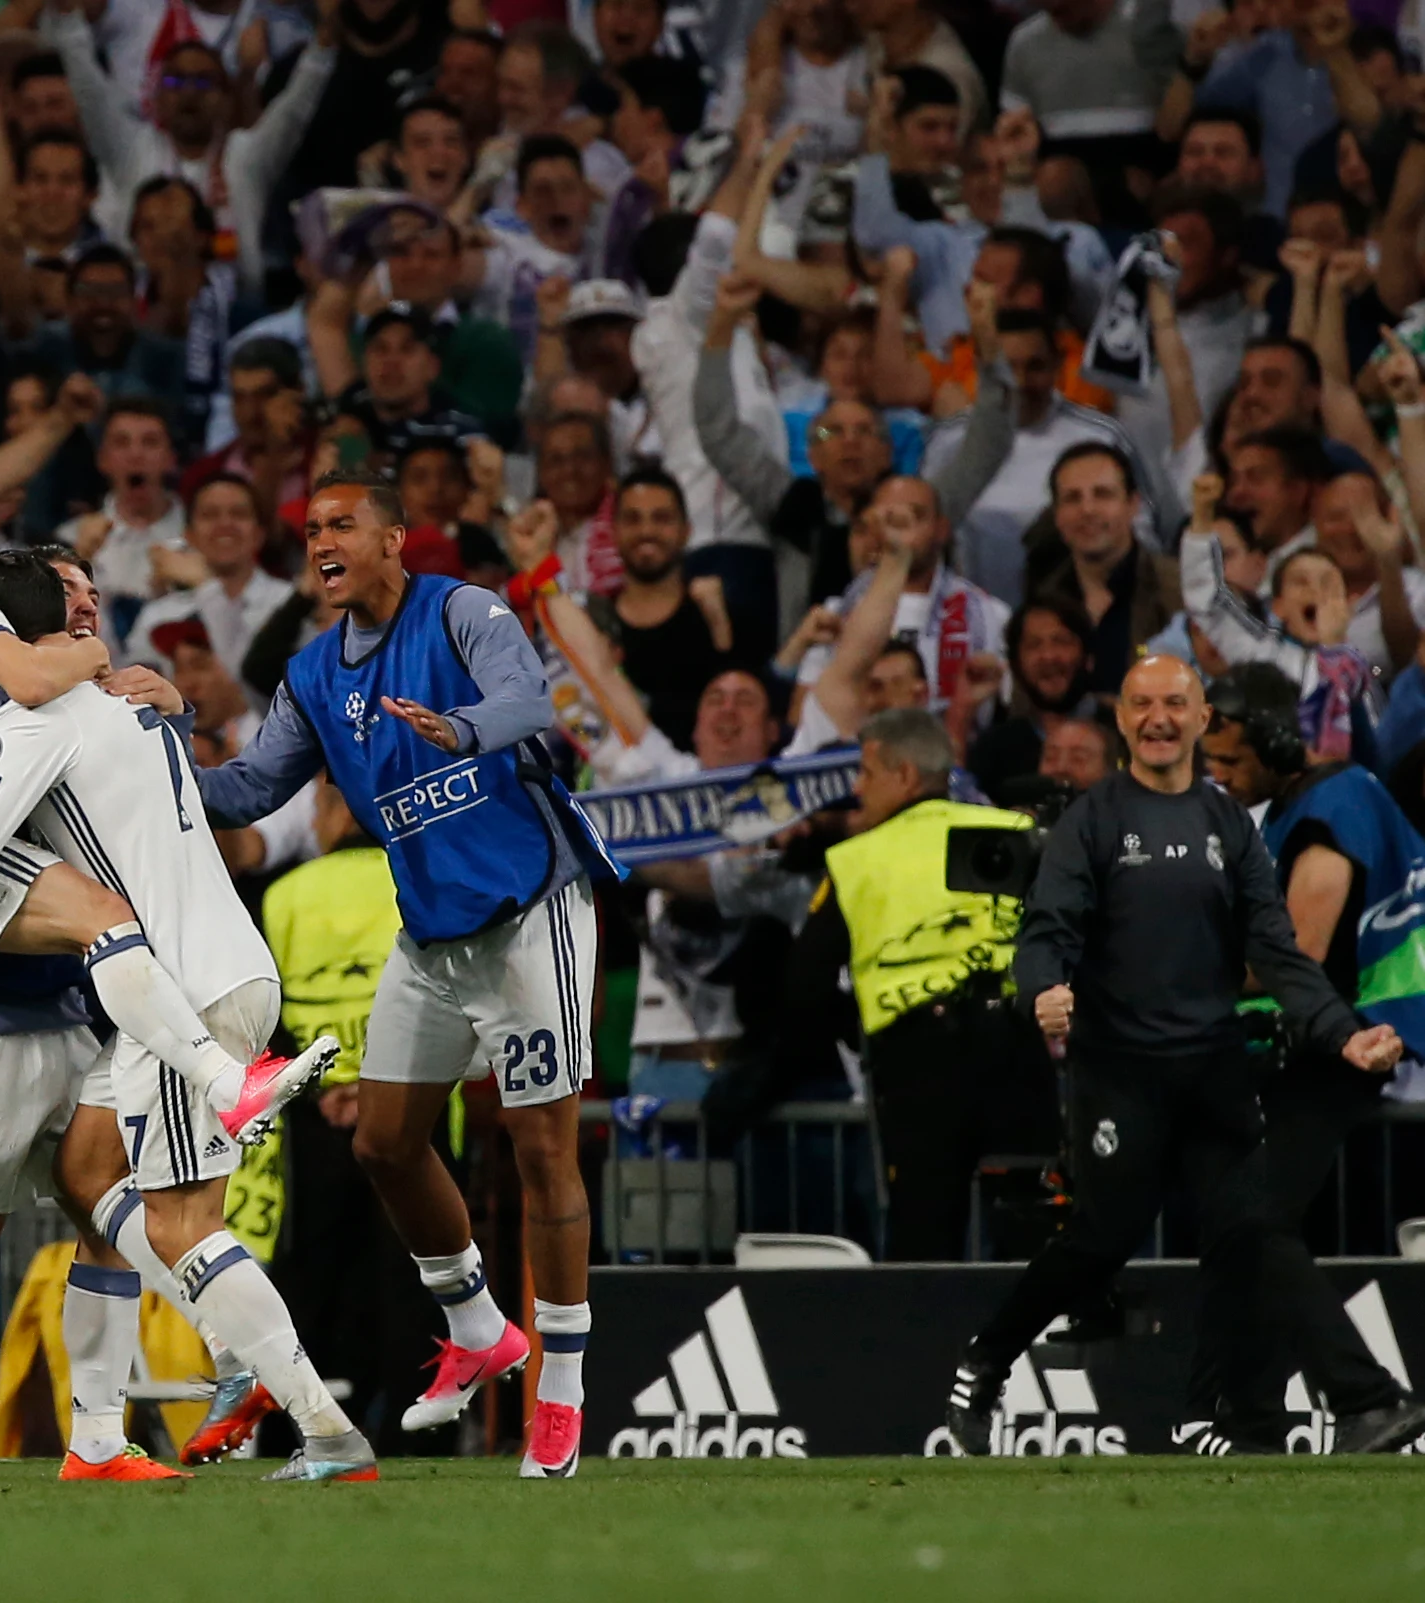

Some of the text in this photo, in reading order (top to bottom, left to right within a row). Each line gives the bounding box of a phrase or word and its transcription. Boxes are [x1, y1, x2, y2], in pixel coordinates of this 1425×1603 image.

[134, 705, 194, 833] 7
[379, 766, 479, 832] REPECT
[1164, 844, 1188, 858] AP
[504, 1028, 558, 1091] 23
[125, 1114, 148, 1174] 7
[225, 1186, 276, 1236] 23
[608, 1410, 807, 1459] adidas
